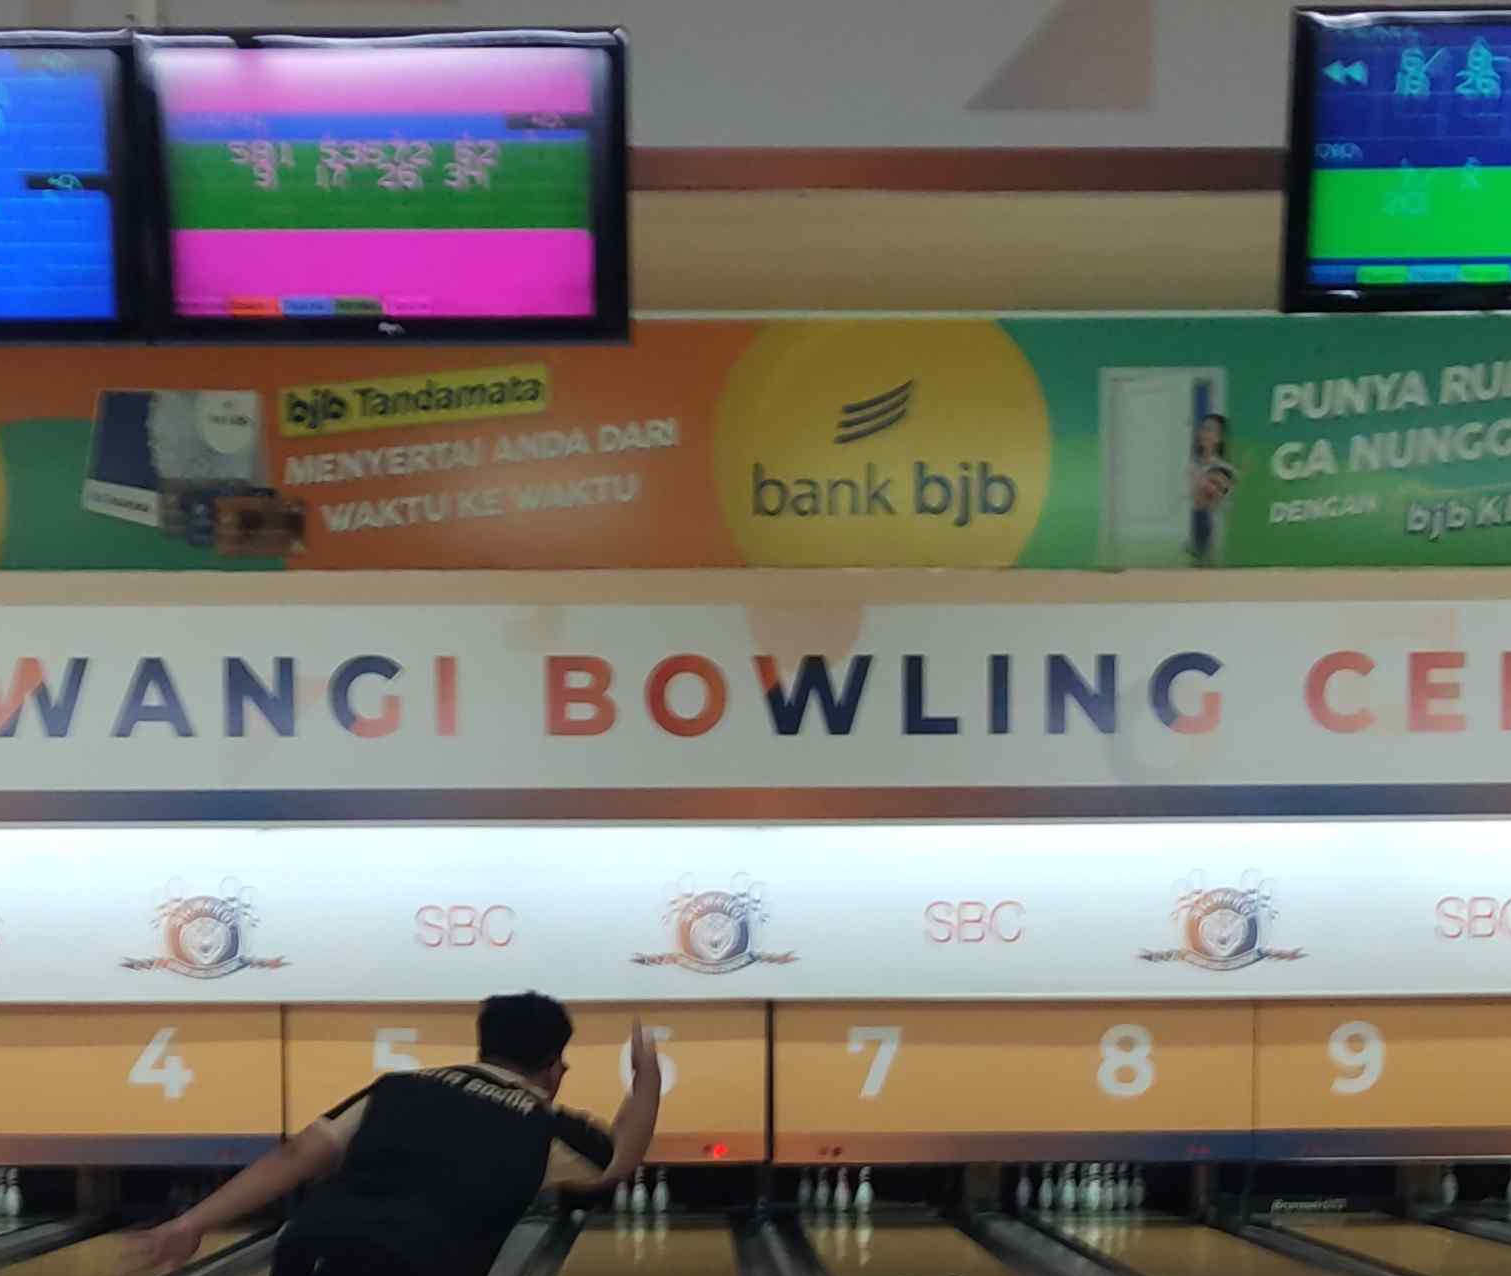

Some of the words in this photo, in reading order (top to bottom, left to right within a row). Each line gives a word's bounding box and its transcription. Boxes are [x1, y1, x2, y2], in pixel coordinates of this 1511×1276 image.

[285, 389, 347, 429] bjb
[353, 376, 543, 417] Tandamata
[1270, 369, 1428, 424] PUNYA
[284, 437, 482, 485] MENYERTAI
[493, 429, 590, 464] ANDA
[597, 417, 680, 453] DARI
[1270, 439, 1338, 480] GA
[322, 494, 448, 533] WAKTU
[456, 487, 504, 519] KE
[514, 474, 640, 511] WAKTU
[752, 462, 896, 517] bank
[913, 461, 1016, 527] bjb
[1269, 495, 1379, 526] DENGAN
[1406, 502, 1467, 541] bjb
[542, 652, 1223, 736] BOWLING
[415, 904, 516, 948] SBC
[923, 900, 1026, 943] SBC
[128, 1027, 192, 1099] 4
[846, 1026, 903, 1098] 7
[1097, 1023, 1155, 1096] 8
[1327, 1020, 1385, 1094] 9
